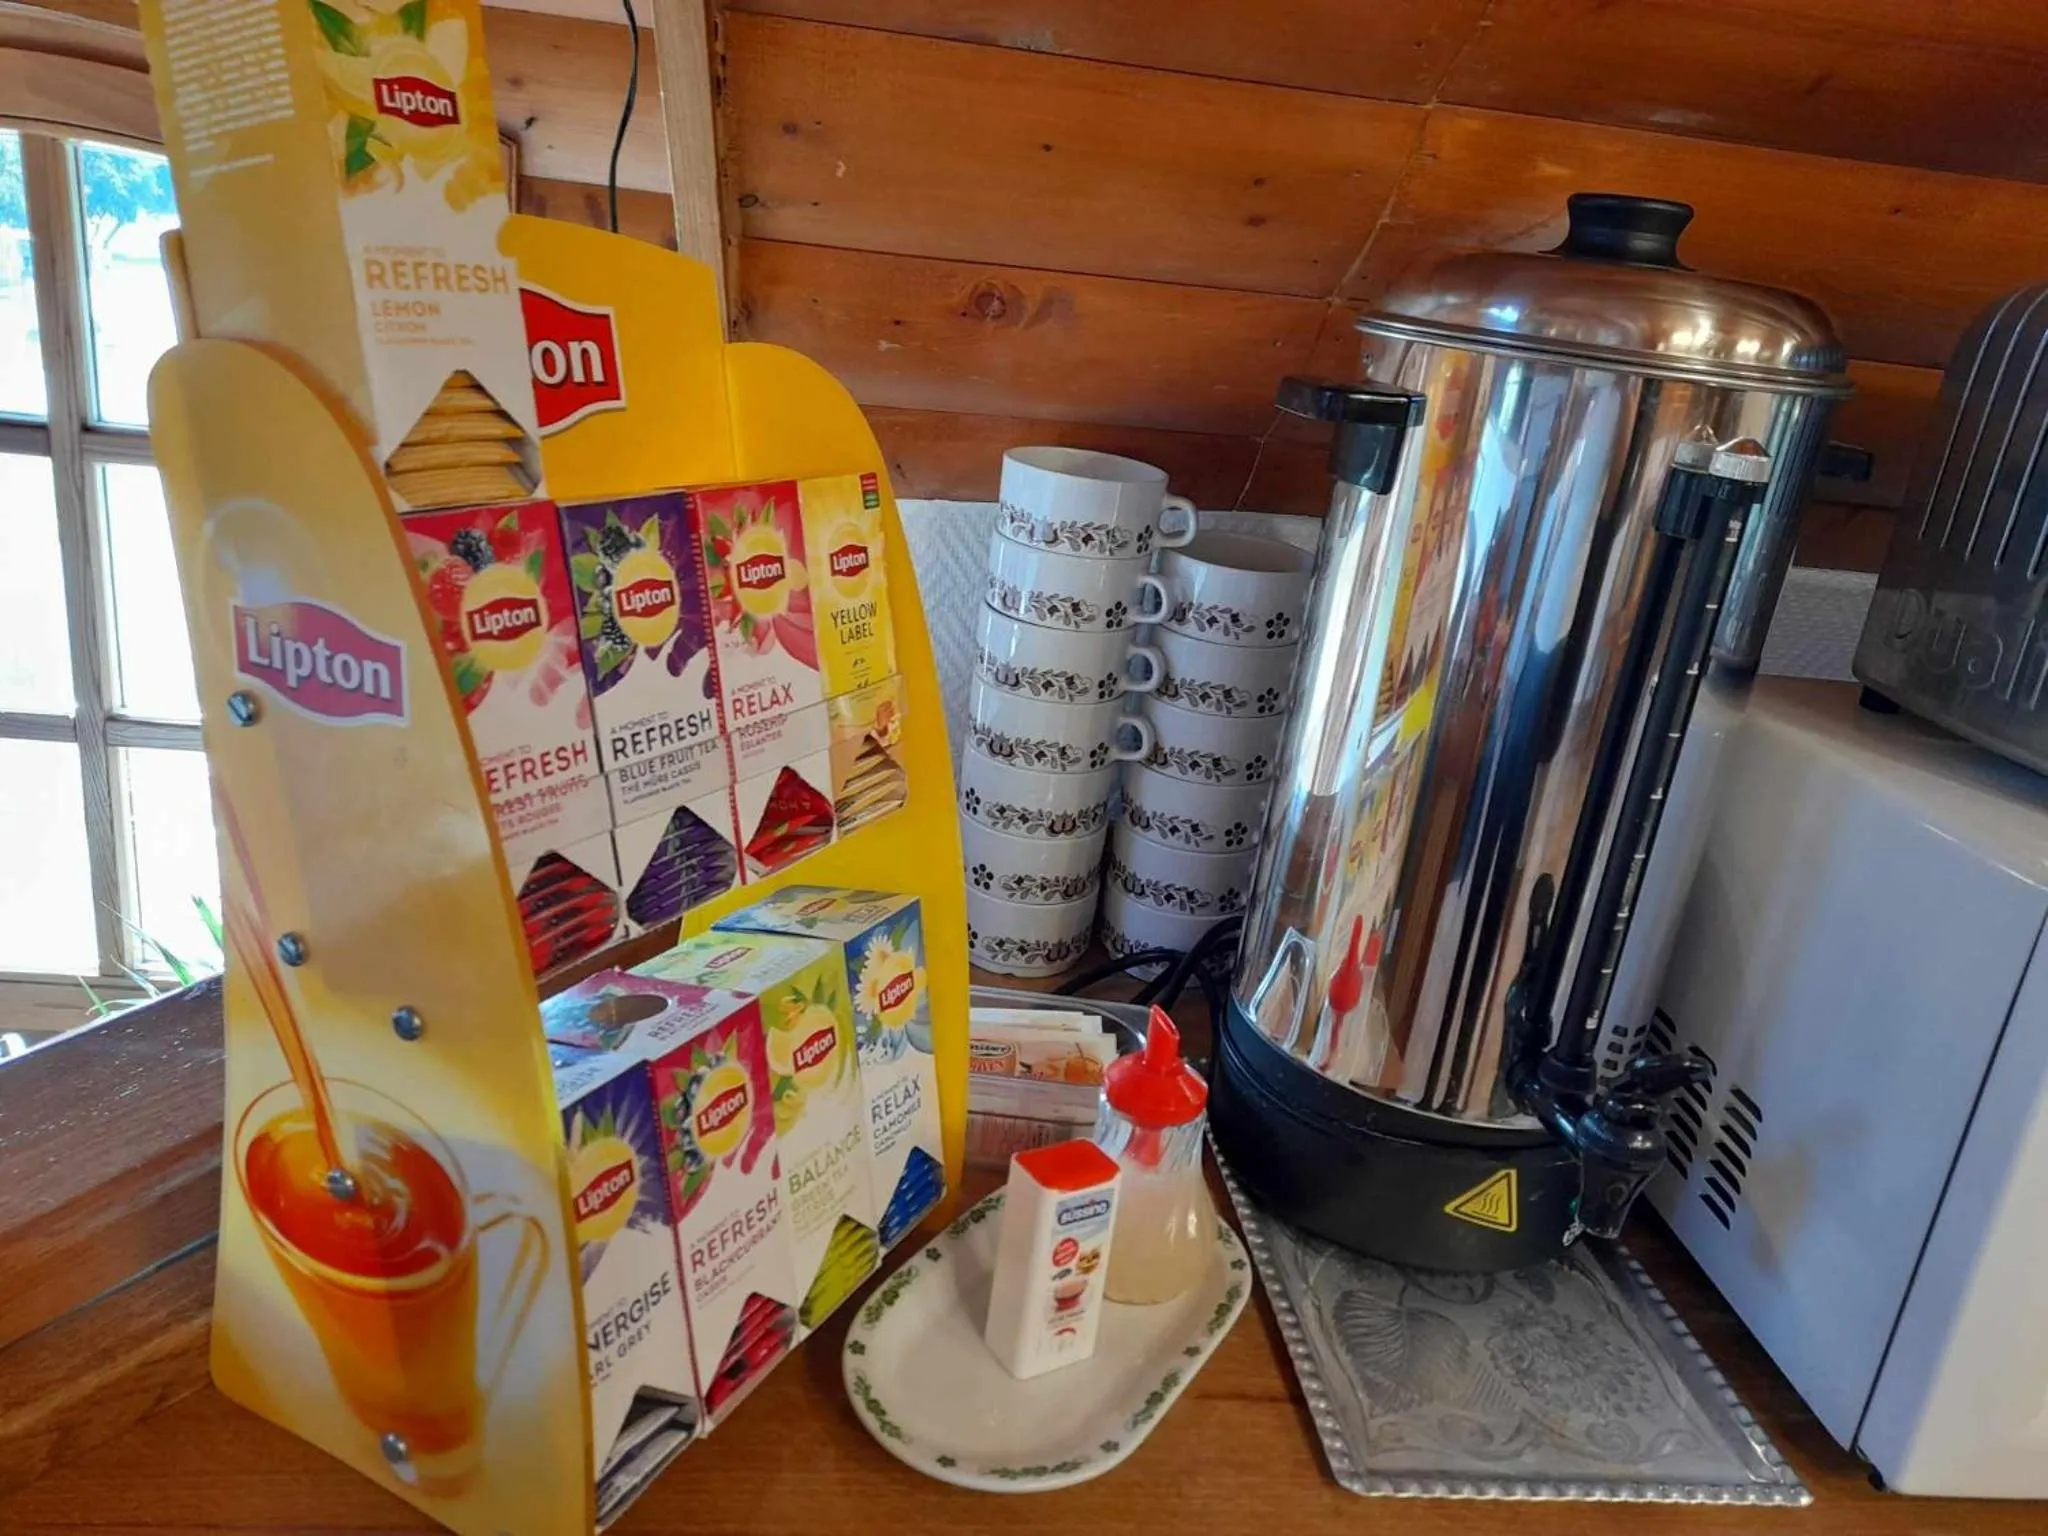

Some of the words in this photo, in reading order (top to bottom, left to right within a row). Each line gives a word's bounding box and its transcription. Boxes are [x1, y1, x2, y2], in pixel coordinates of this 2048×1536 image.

[380, 84, 453, 117] Lipton
[364, 259, 509, 294] REFRESH
[371, 300, 441, 317] LEMON
[529, 339, 607, 386] on
[740, 561, 782, 585] Lipton
[834, 551, 867, 573] Lipton
[620, 585, 672, 613] Lipton
[831, 601, 878, 629] YELLOW
[472, 606, 537, 635] Lipton
[840, 622, 874, 645] LABEL
[243, 610, 392, 700] Lipton
[732, 682, 794, 721] RELAX
[612, 708, 712, 762] REFRESH
[485, 740, 589, 794] EFRESH
[620, 759, 656, 783] BLUE
[659, 744, 695, 770] FRUIT
[881, 975, 913, 1006] Lipton
[795, 1033, 834, 1066] Lipton
[700, 1092, 745, 1129] Lipton
[871, 1074, 921, 1124] RELAX
[788, 1124, 862, 1195] BALANCE
[578, 1168, 631, 1216] Lipton
[690, 1188, 779, 1273] REFRESH
[586, 1271, 672, 1353] NERGISE
